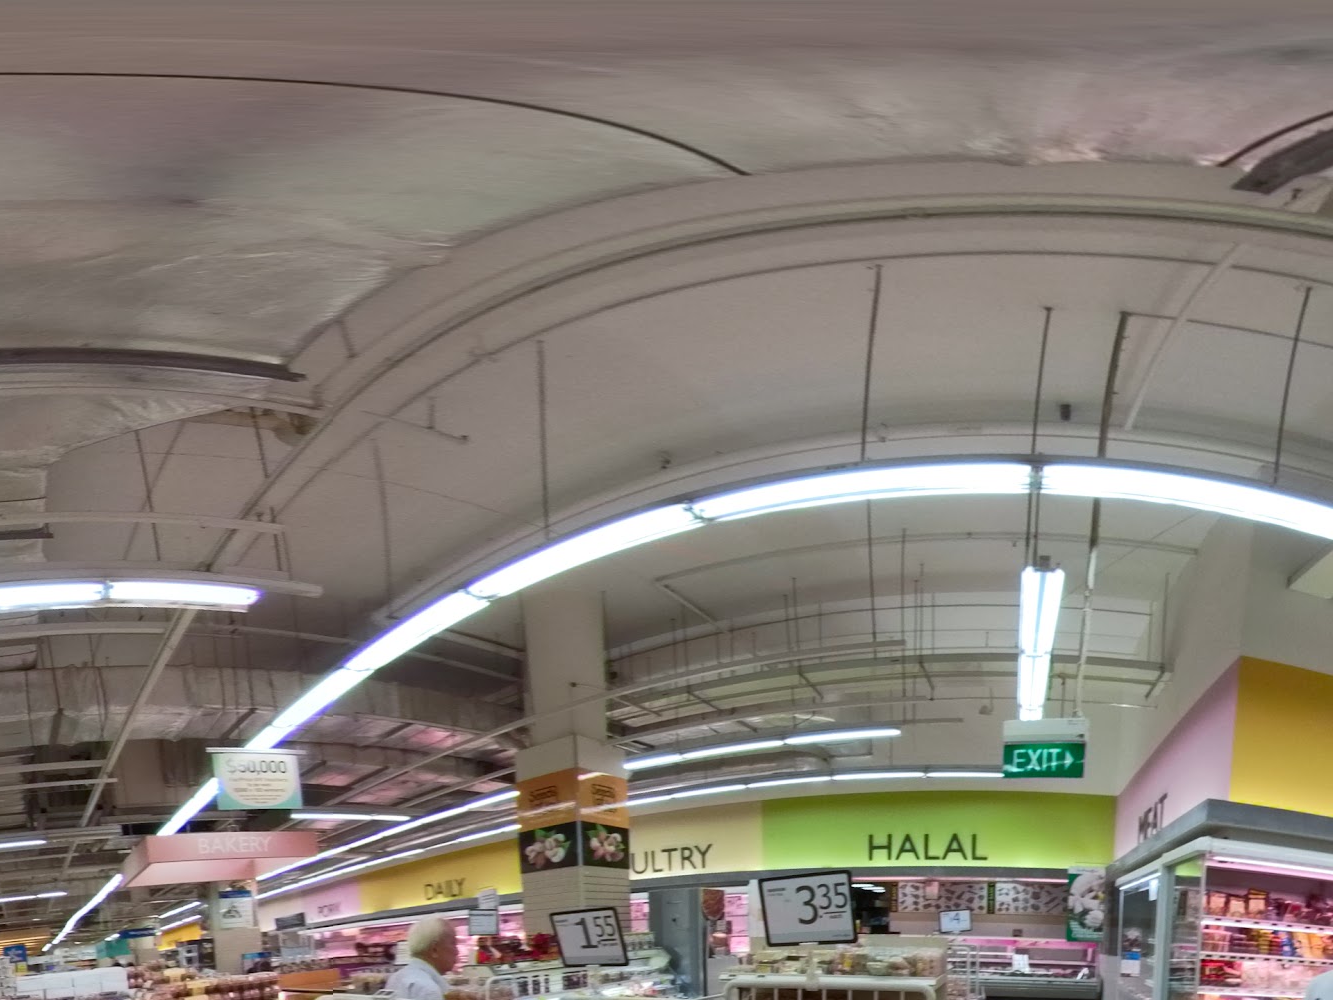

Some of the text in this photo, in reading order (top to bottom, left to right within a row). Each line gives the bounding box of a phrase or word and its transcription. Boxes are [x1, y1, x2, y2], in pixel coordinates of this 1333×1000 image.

[1013, 748, 1062, 772] EXIT
[1138, 793, 1169, 843] MEAT
[197, 837, 272, 854] BAKERY
[631, 843, 713, 875] ULTRY
[868, 833, 989, 861] HALAL
[424, 877, 466, 900] DAILY
[795, 882, 848, 925] 3.35
